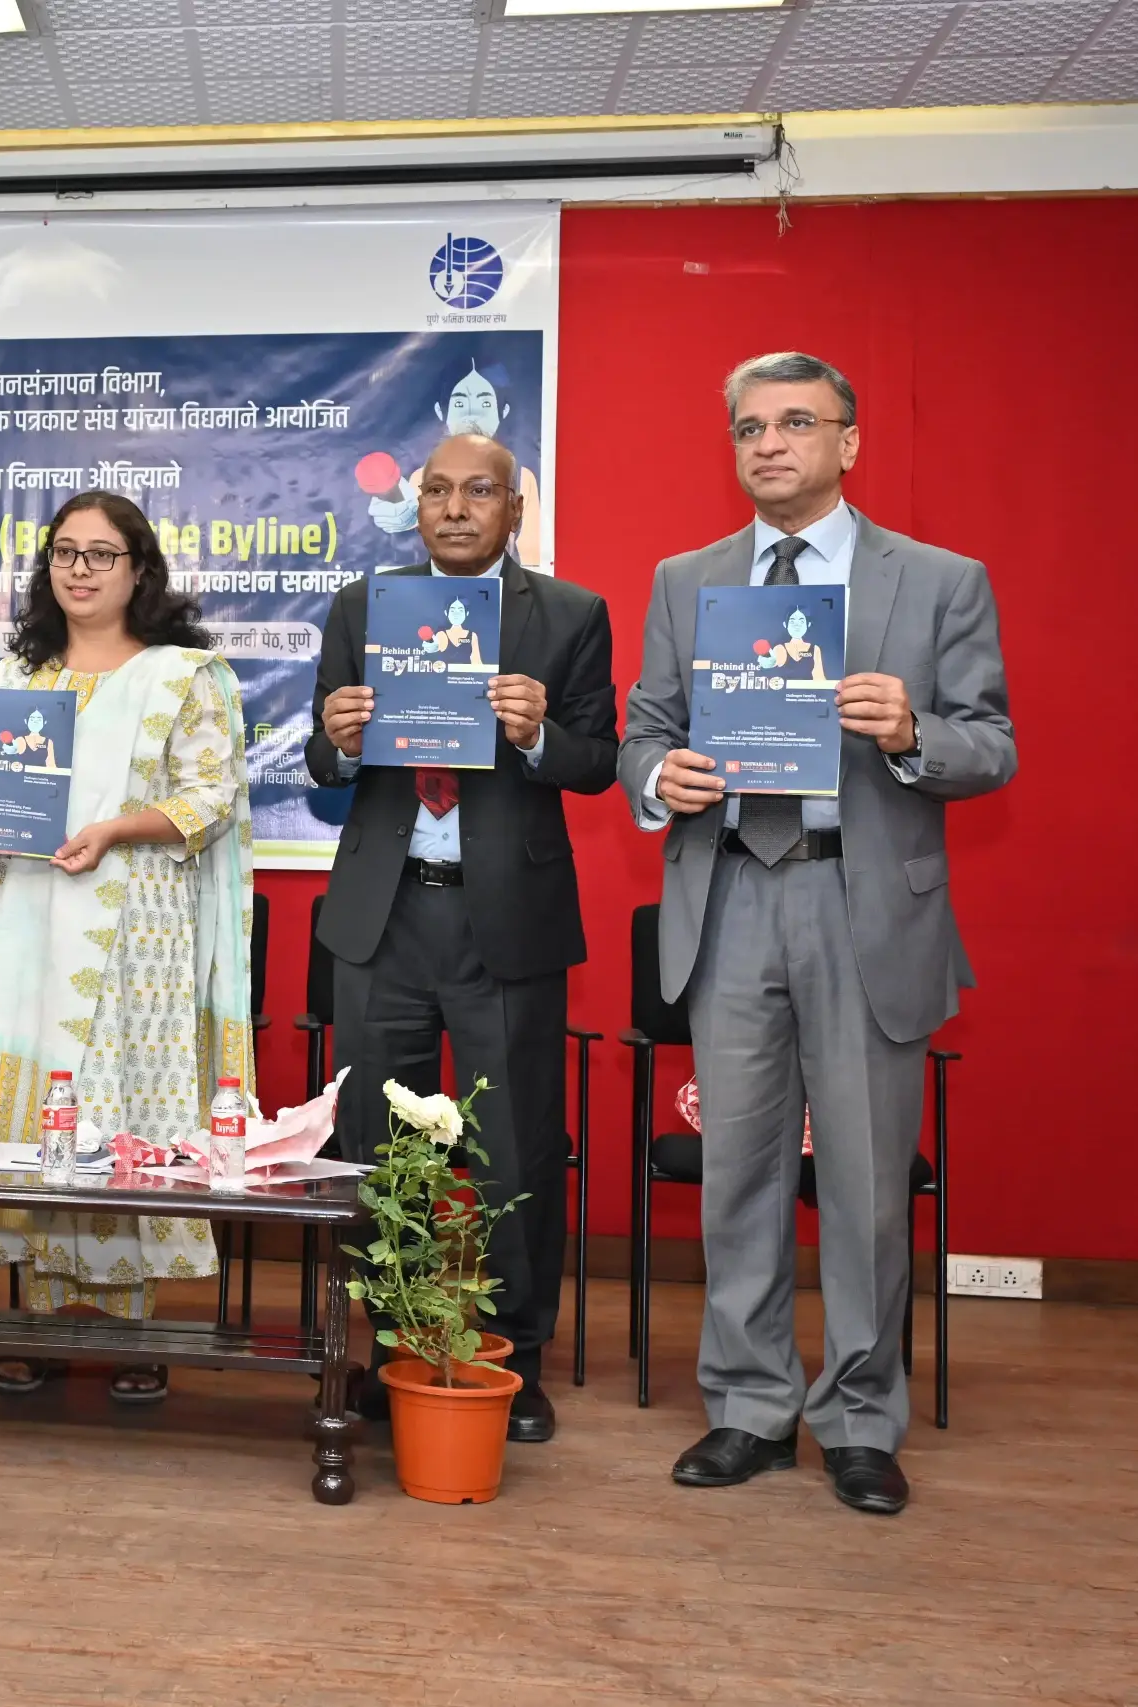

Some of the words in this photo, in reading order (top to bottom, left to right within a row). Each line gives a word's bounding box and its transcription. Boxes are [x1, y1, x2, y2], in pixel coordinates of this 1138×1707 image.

[101, 366, 166, 397] विभाग,
[14, 409, 80, 431] पत्रकार
[83, 404, 119, 431] संघ
[122, 404, 177, 431] यांच्या
[180, 400, 260, 429] विद्यमाने
[264, 399, 350, 428] आयोजित
[7, 461, 83, 490] दिनाच्या
[88, 459, 182, 490] औचित्याने
[211, 512, 337, 562] Byline)
[198, 570, 278, 593] प्रकाशन
[231, 628, 257, 649] नवी
[261, 629, 283, 650] पेठ,
[287, 629, 311, 653] पुणे
[746, 663, 762, 671] the
